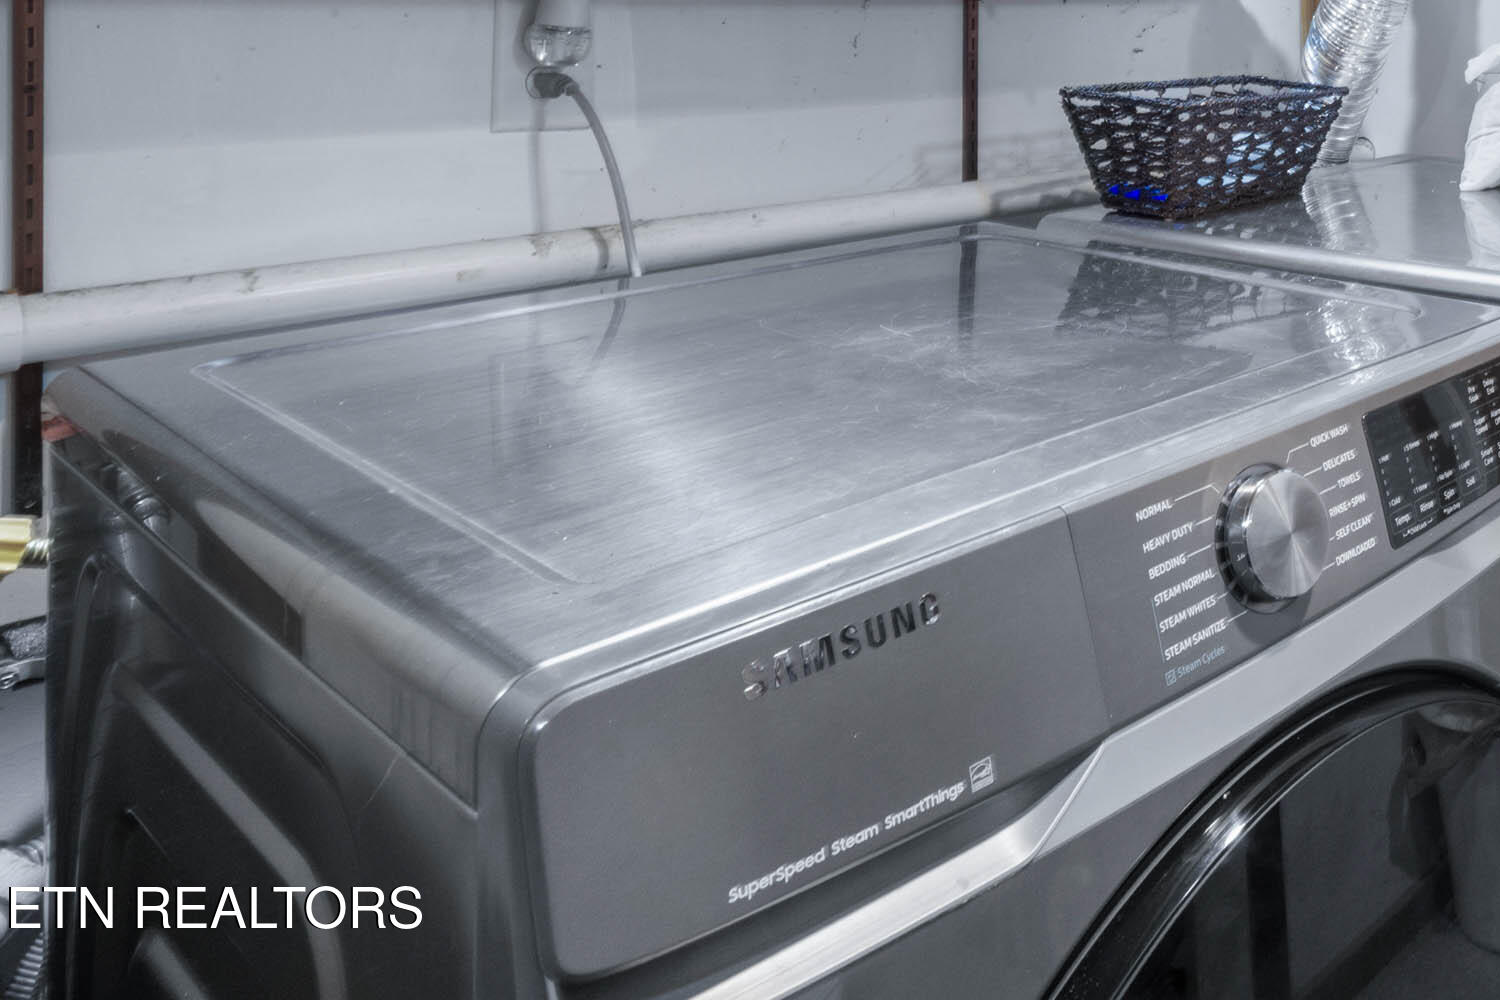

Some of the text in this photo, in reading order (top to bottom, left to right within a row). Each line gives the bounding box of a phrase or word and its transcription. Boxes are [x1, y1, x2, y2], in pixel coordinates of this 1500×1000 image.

[1310, 423, 1349, 448] QUICK WASH
[1322, 449, 1356, 472] DELICATES
[1337, 471, 1361, 488] TOWELS
[1135, 499, 1173, 523] NORMAL
[1142, 521, 1194, 554] HEAVY DUTY
[1335, 524, 1350, 540] SELF
[1148, 552, 1187, 580] BEDDING
[1335, 537, 1376, 566] DOWNLOADED
[1153, 568, 1216, 607] STEAM NORMAL
[1159, 594, 1217, 633] STEAM WHITES
[741, 591, 941, 701] SAMSUNG
[1164, 618, 1227, 661] STEAM SANITIZE
[1176, 646, 1225, 678] Steam Cycles
[728, 780, 965, 904] SuperSpeed Steam SmartThings
